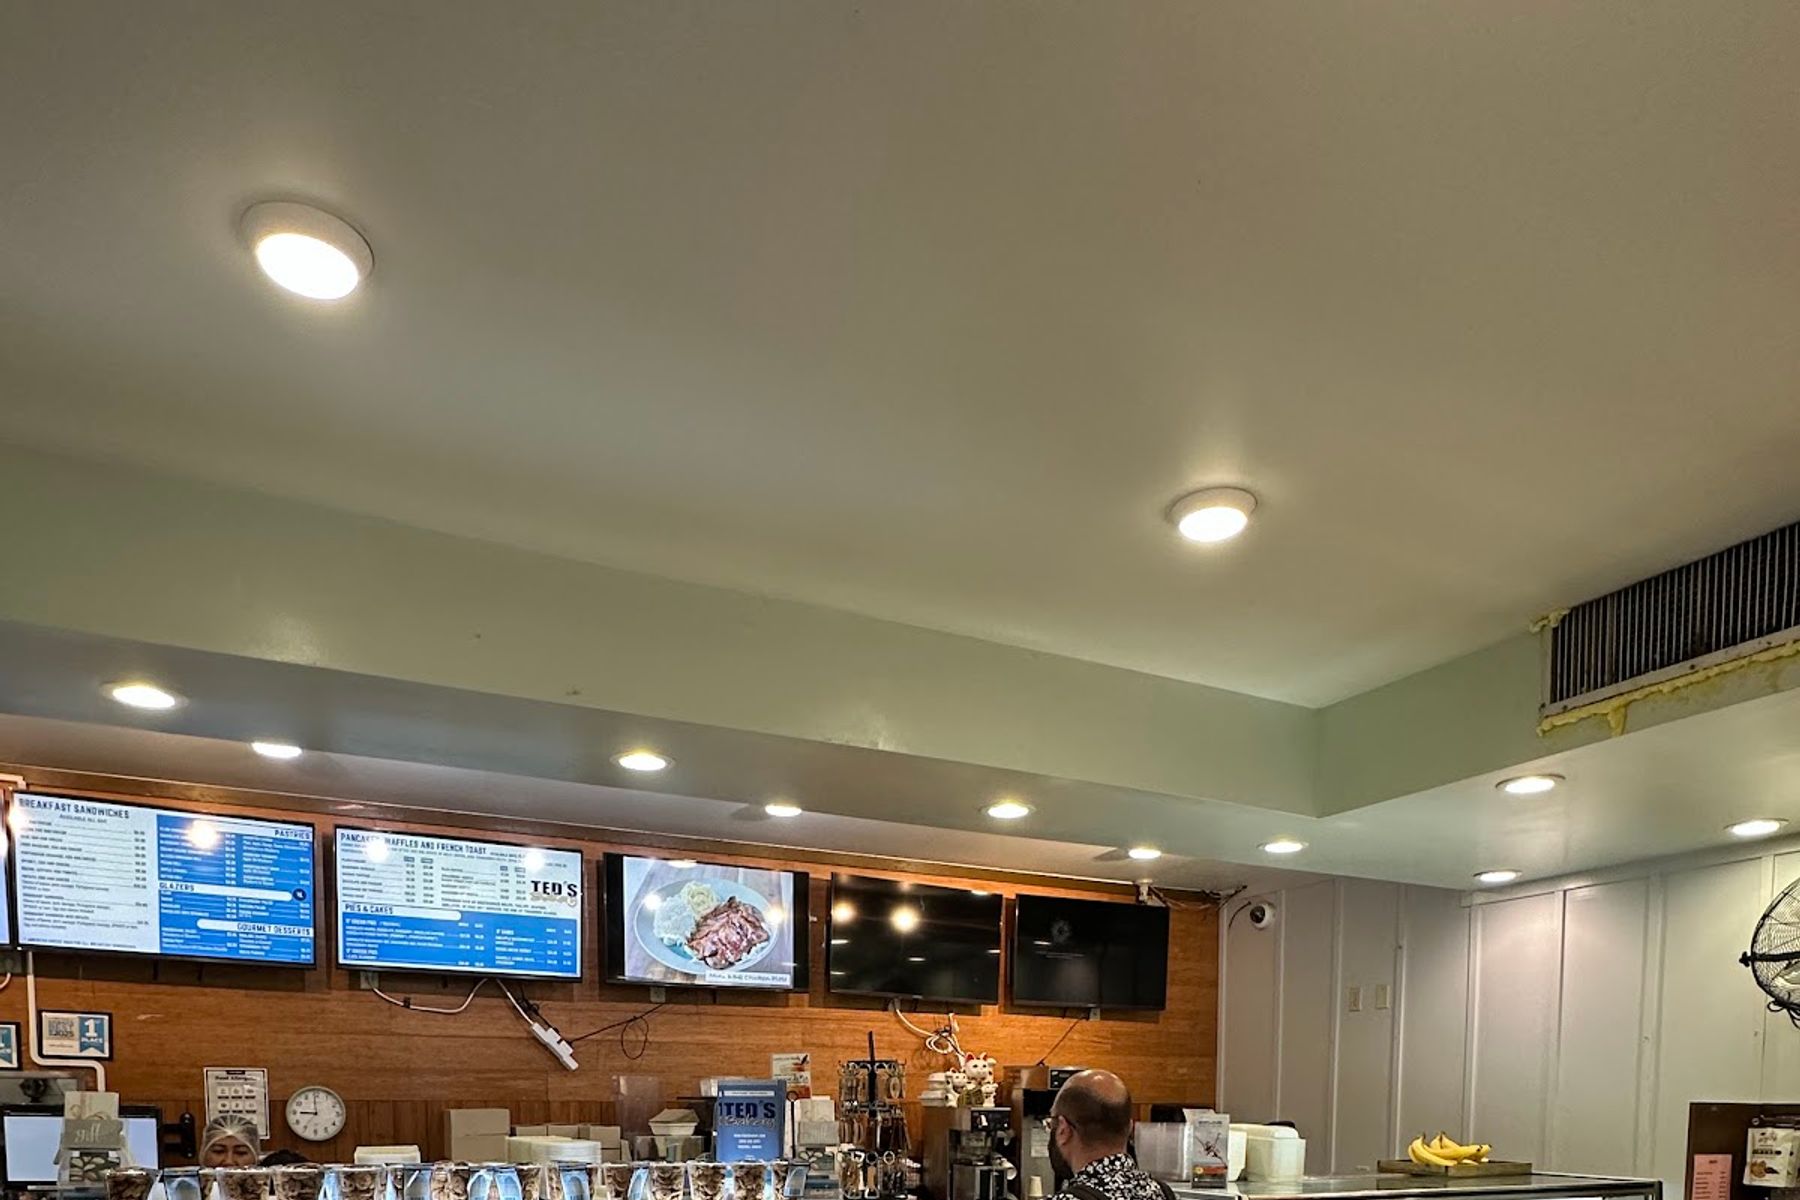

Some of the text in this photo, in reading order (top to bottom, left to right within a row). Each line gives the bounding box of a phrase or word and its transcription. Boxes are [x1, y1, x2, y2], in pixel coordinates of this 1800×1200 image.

[19, 798, 130, 819] BREAKFAST SANDWICHES
[274, 829, 310, 840] PASTRIES
[385, 838, 419, 848] WAFFLES
[420, 841, 434, 850] AND
[436, 842, 463, 852] FRENCH
[465, 845, 487, 855] TOAST
[159, 882, 195, 892] GLAZERS
[530, 880, 578, 898] TED'S
[345, 903, 361, 912] PIES
[370, 905, 393, 914] CAKES
[236, 922, 310, 936] GOURMET DESSERTS
[724, 1100, 776, 1119] TED'S
